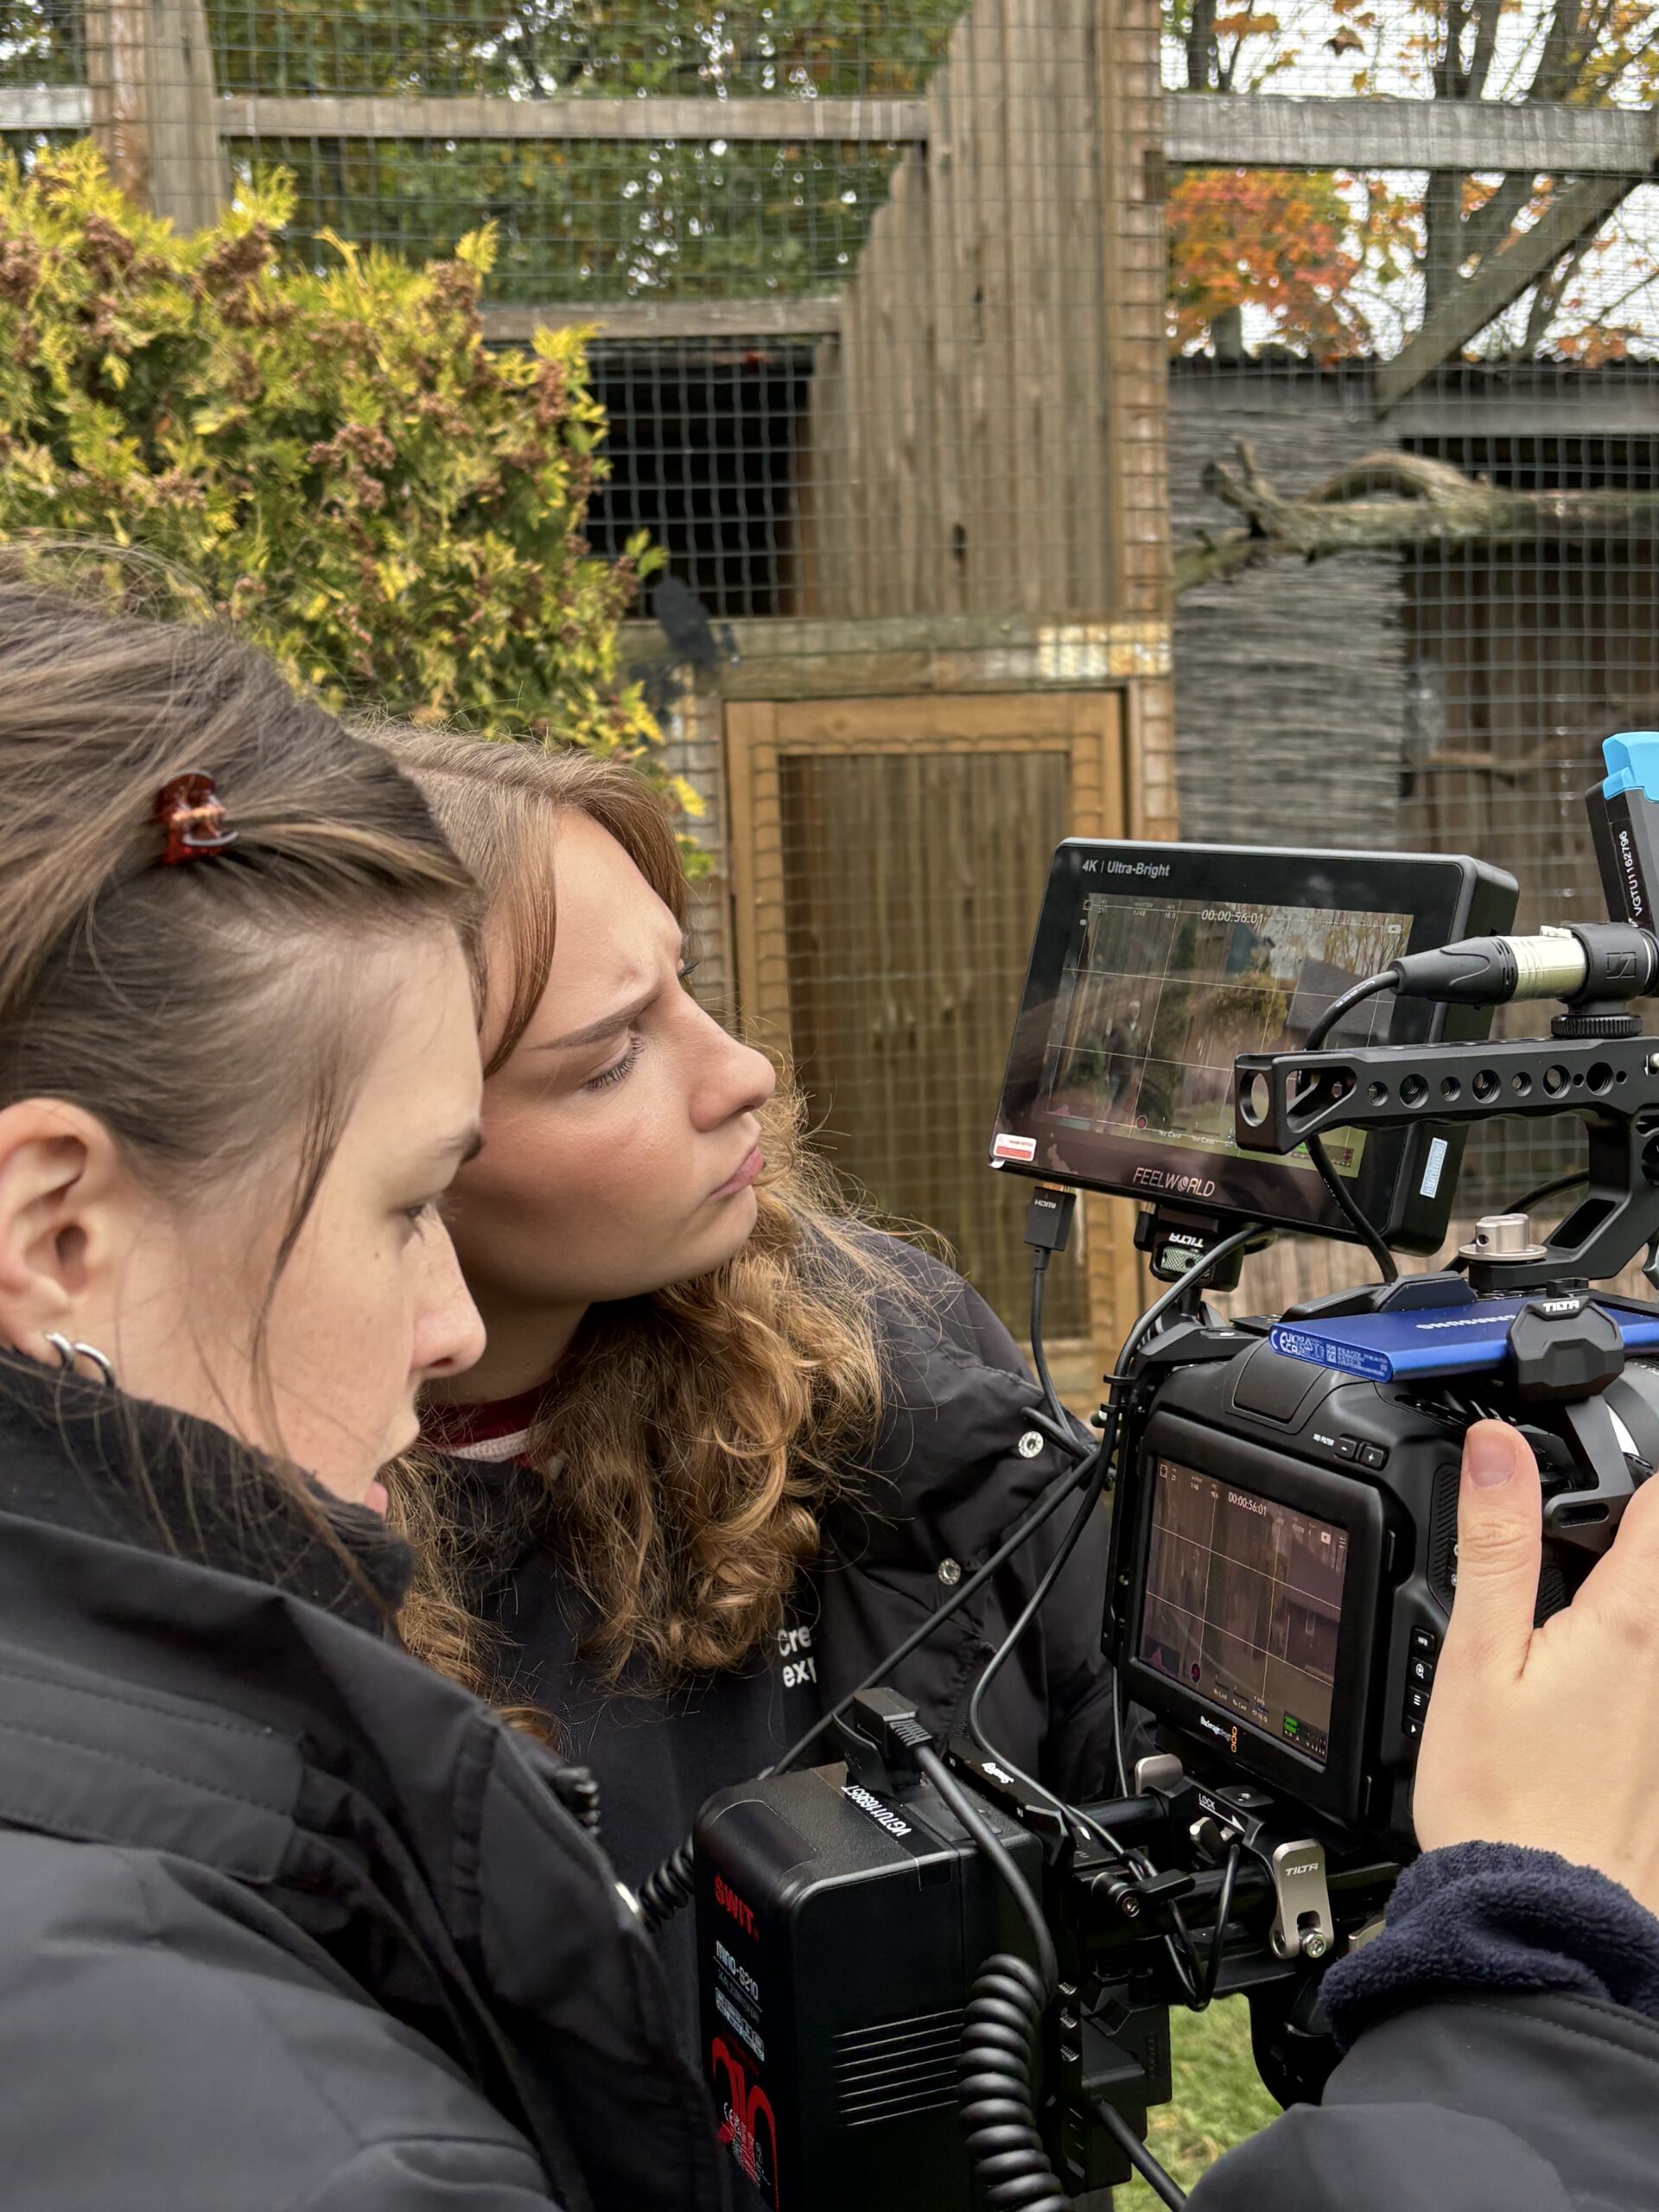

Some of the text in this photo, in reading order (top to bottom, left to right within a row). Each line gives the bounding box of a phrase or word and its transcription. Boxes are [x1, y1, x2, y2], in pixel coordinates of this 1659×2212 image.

[1082, 859, 1170, 879] 4K Ultra-Bright
[1133, 1167, 1215, 1197] FEELWORLD
[1541, 1300, 1580, 1313] TILTA
[1198, 1793, 1216, 1810] LOCK
[1286, 1863, 1319, 1877] TILTA
